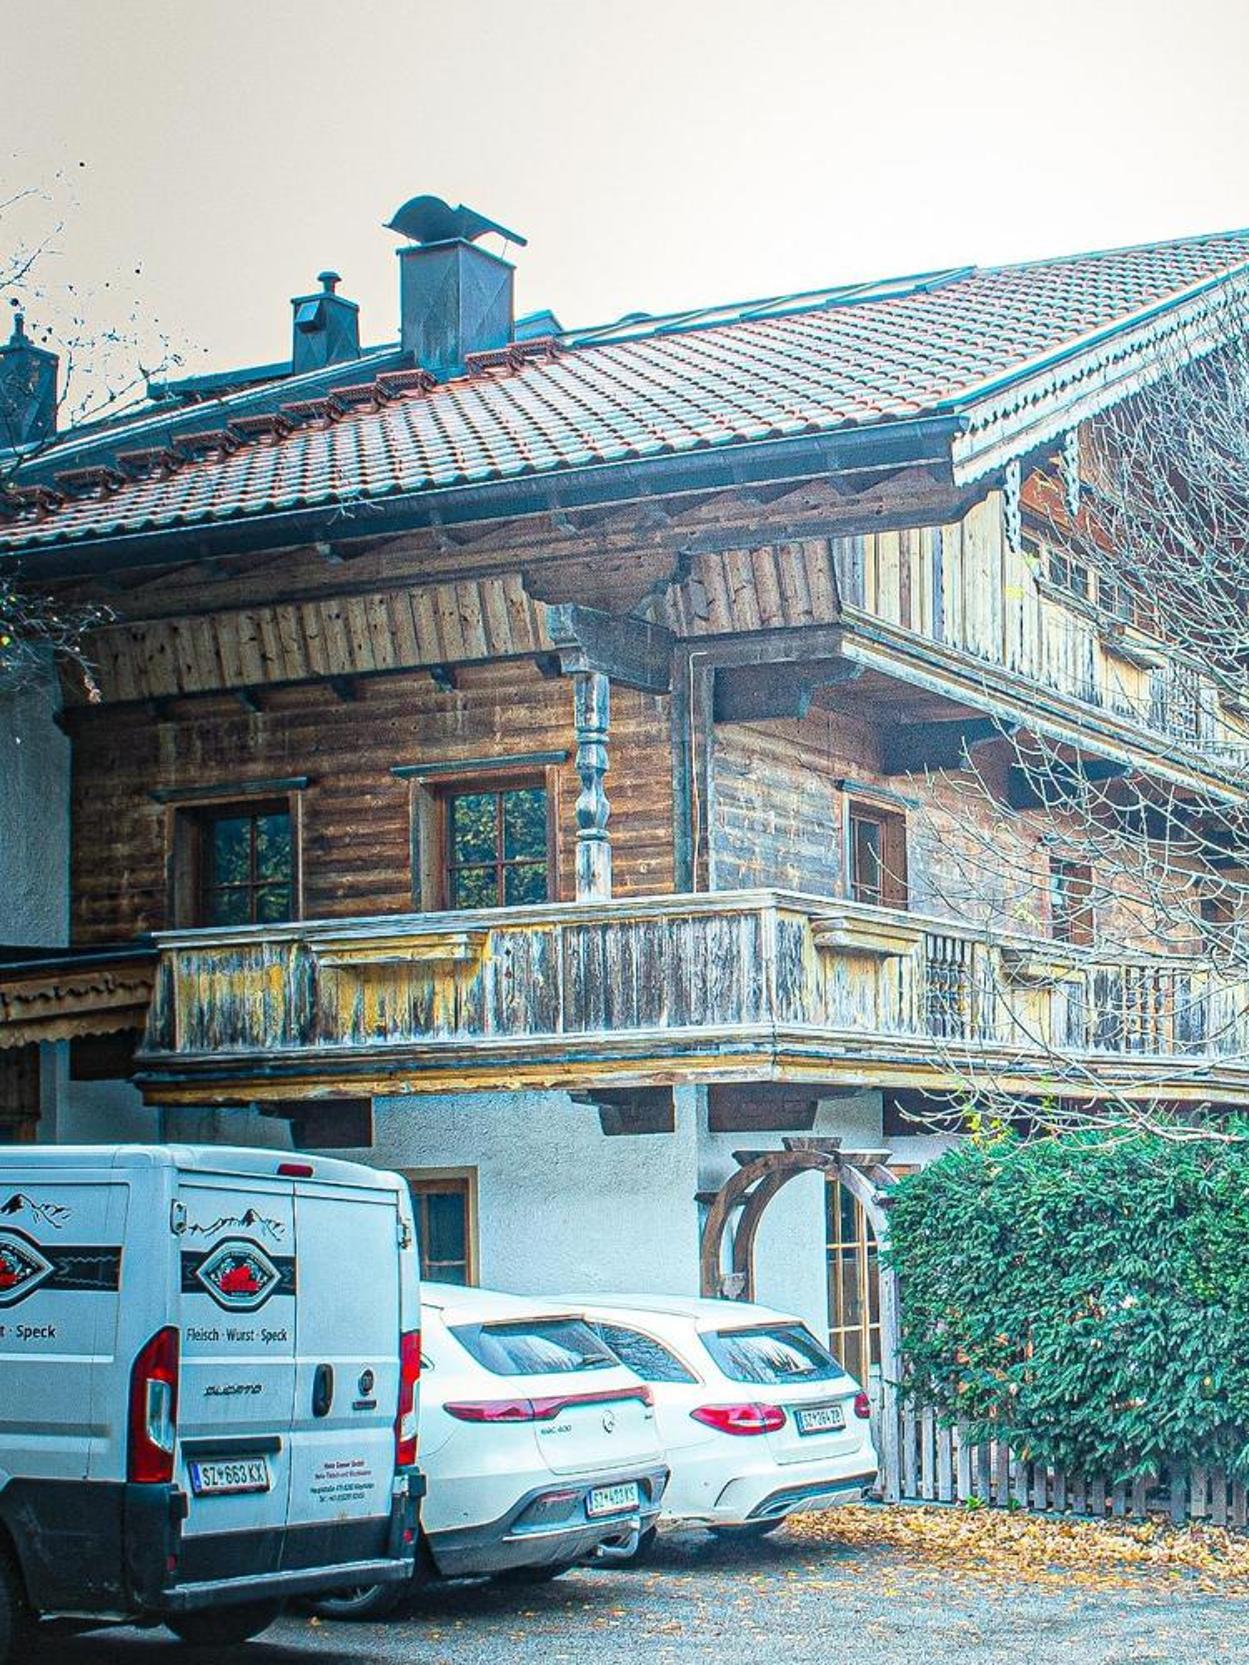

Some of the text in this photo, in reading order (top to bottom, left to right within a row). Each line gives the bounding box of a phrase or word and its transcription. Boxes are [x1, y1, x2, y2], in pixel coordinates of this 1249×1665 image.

[16, 1325, 56, 1341] Speck
[187, 1328, 287, 1345] Fleisch Wurst Speck
